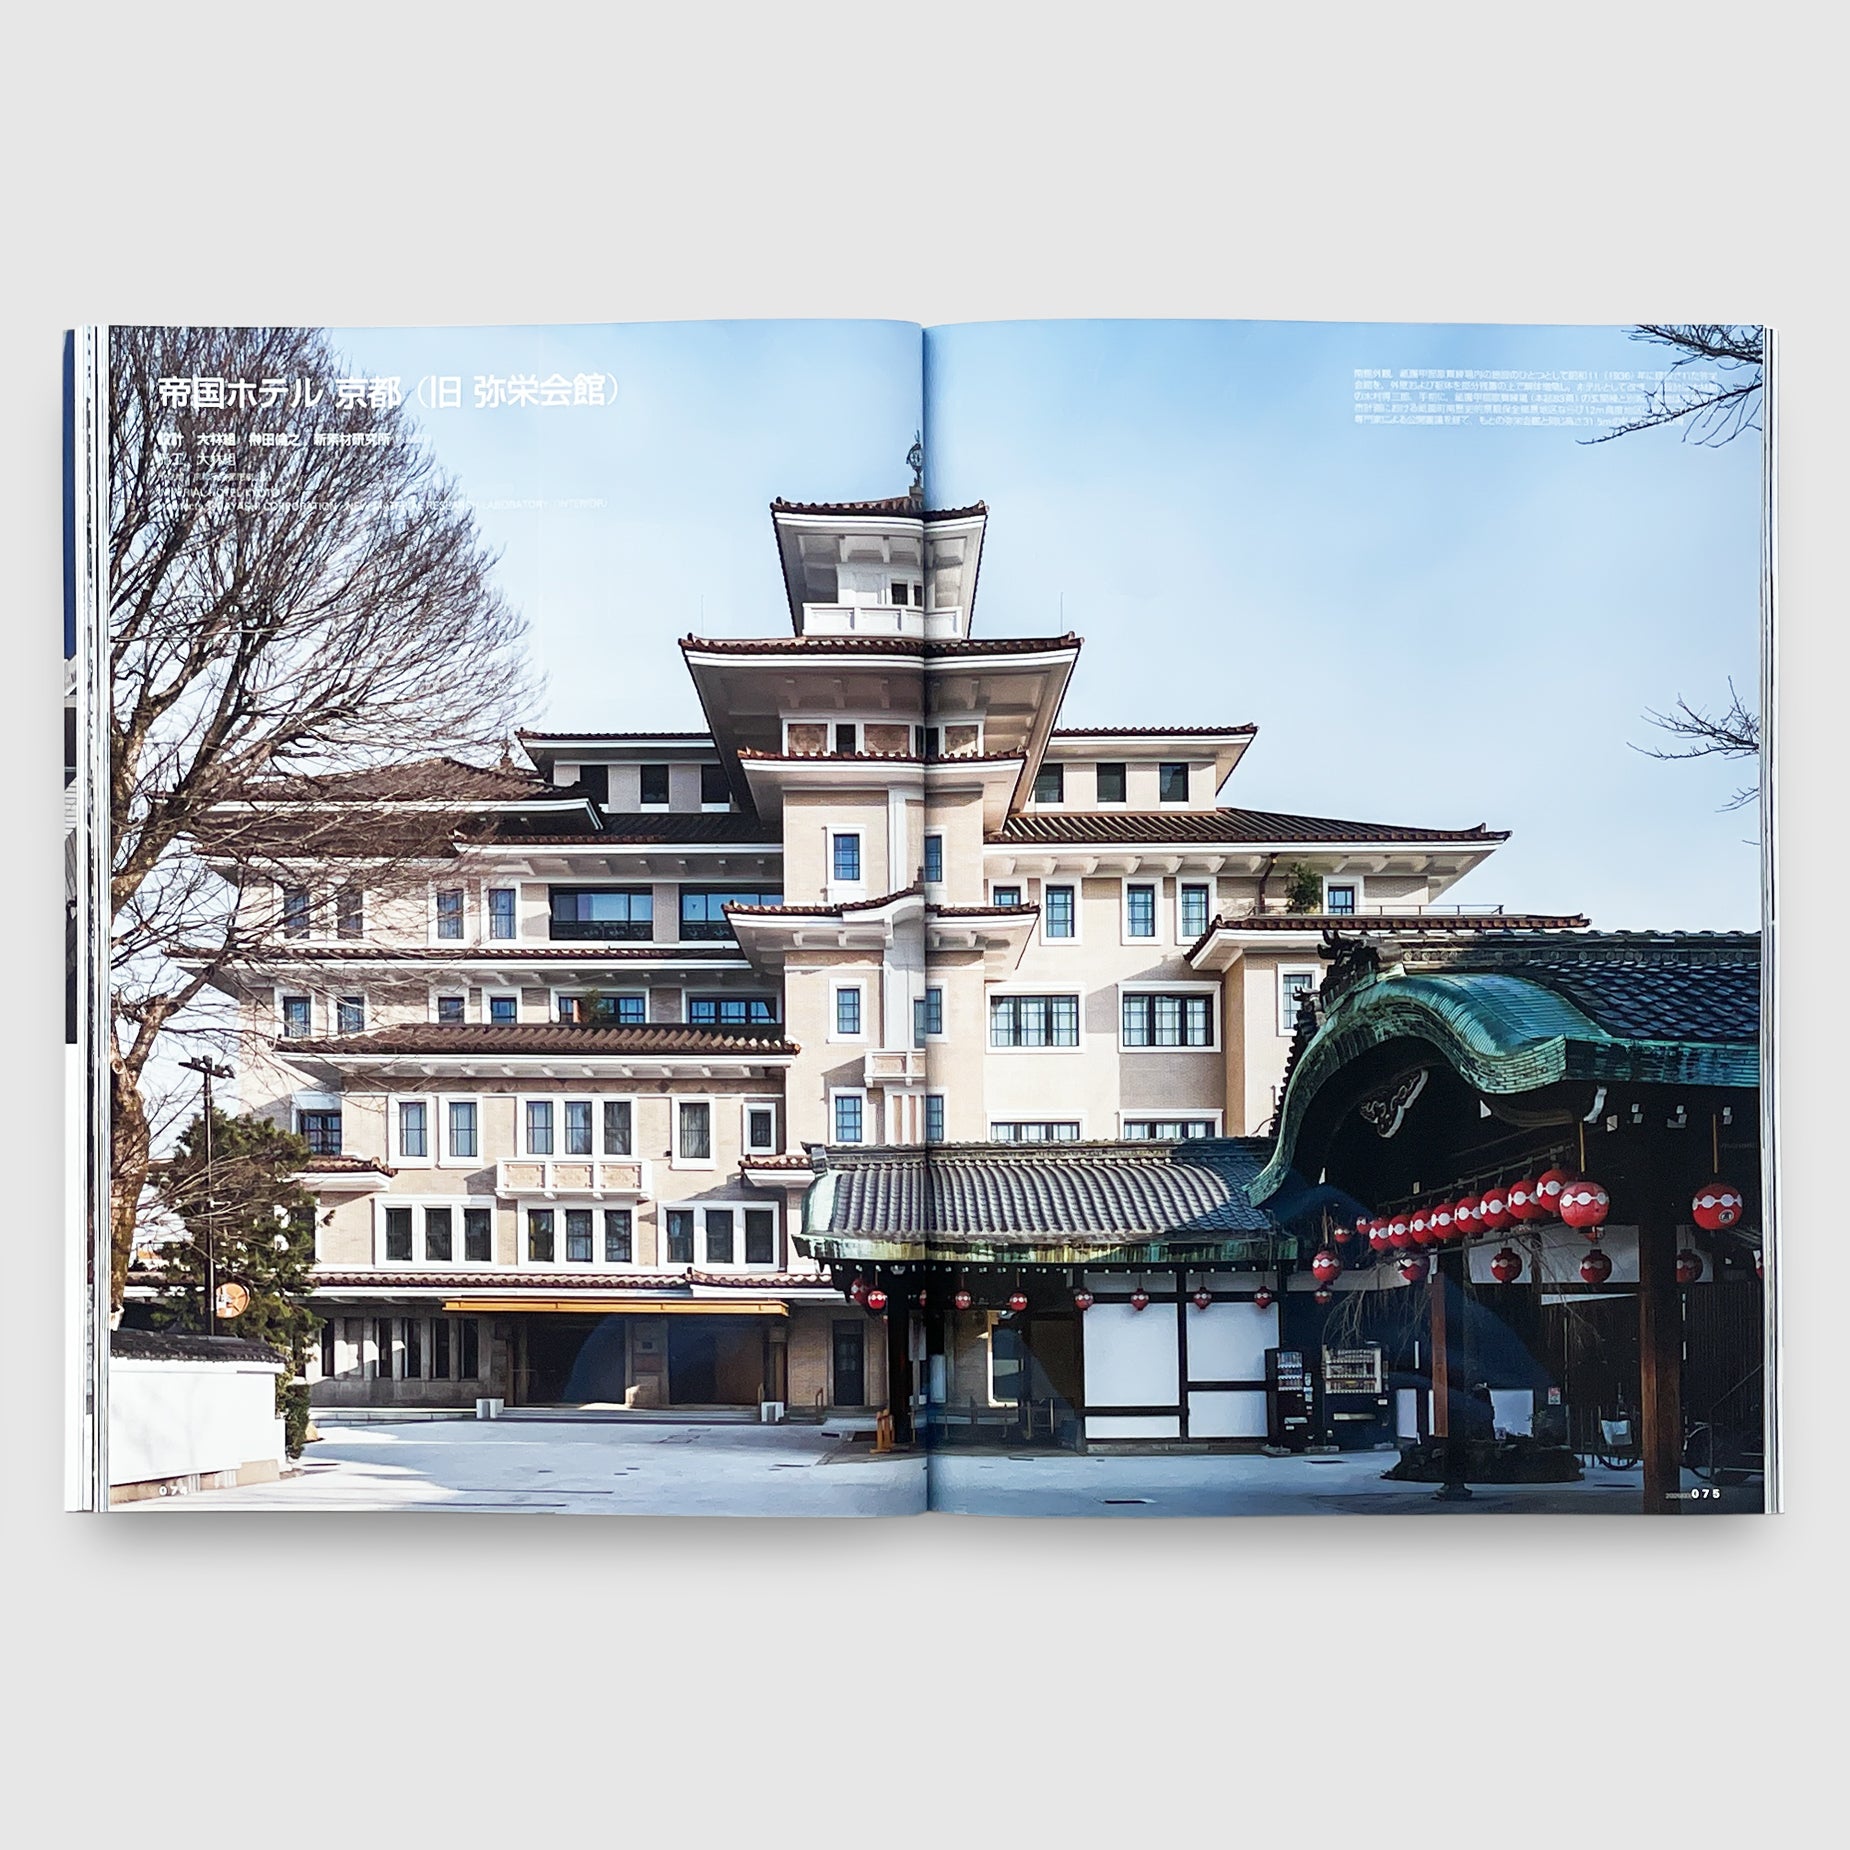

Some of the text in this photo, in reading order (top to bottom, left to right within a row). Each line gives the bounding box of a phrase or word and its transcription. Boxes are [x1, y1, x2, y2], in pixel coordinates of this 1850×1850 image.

[158, 376, 323, 409] 帝国ホテル
[336, 376, 400, 409] 京都
[197, 432, 236, 447] 大林組
[314, 432, 391, 447] 新素材研究所
[1691, 1489, 1720, 1499] 075
